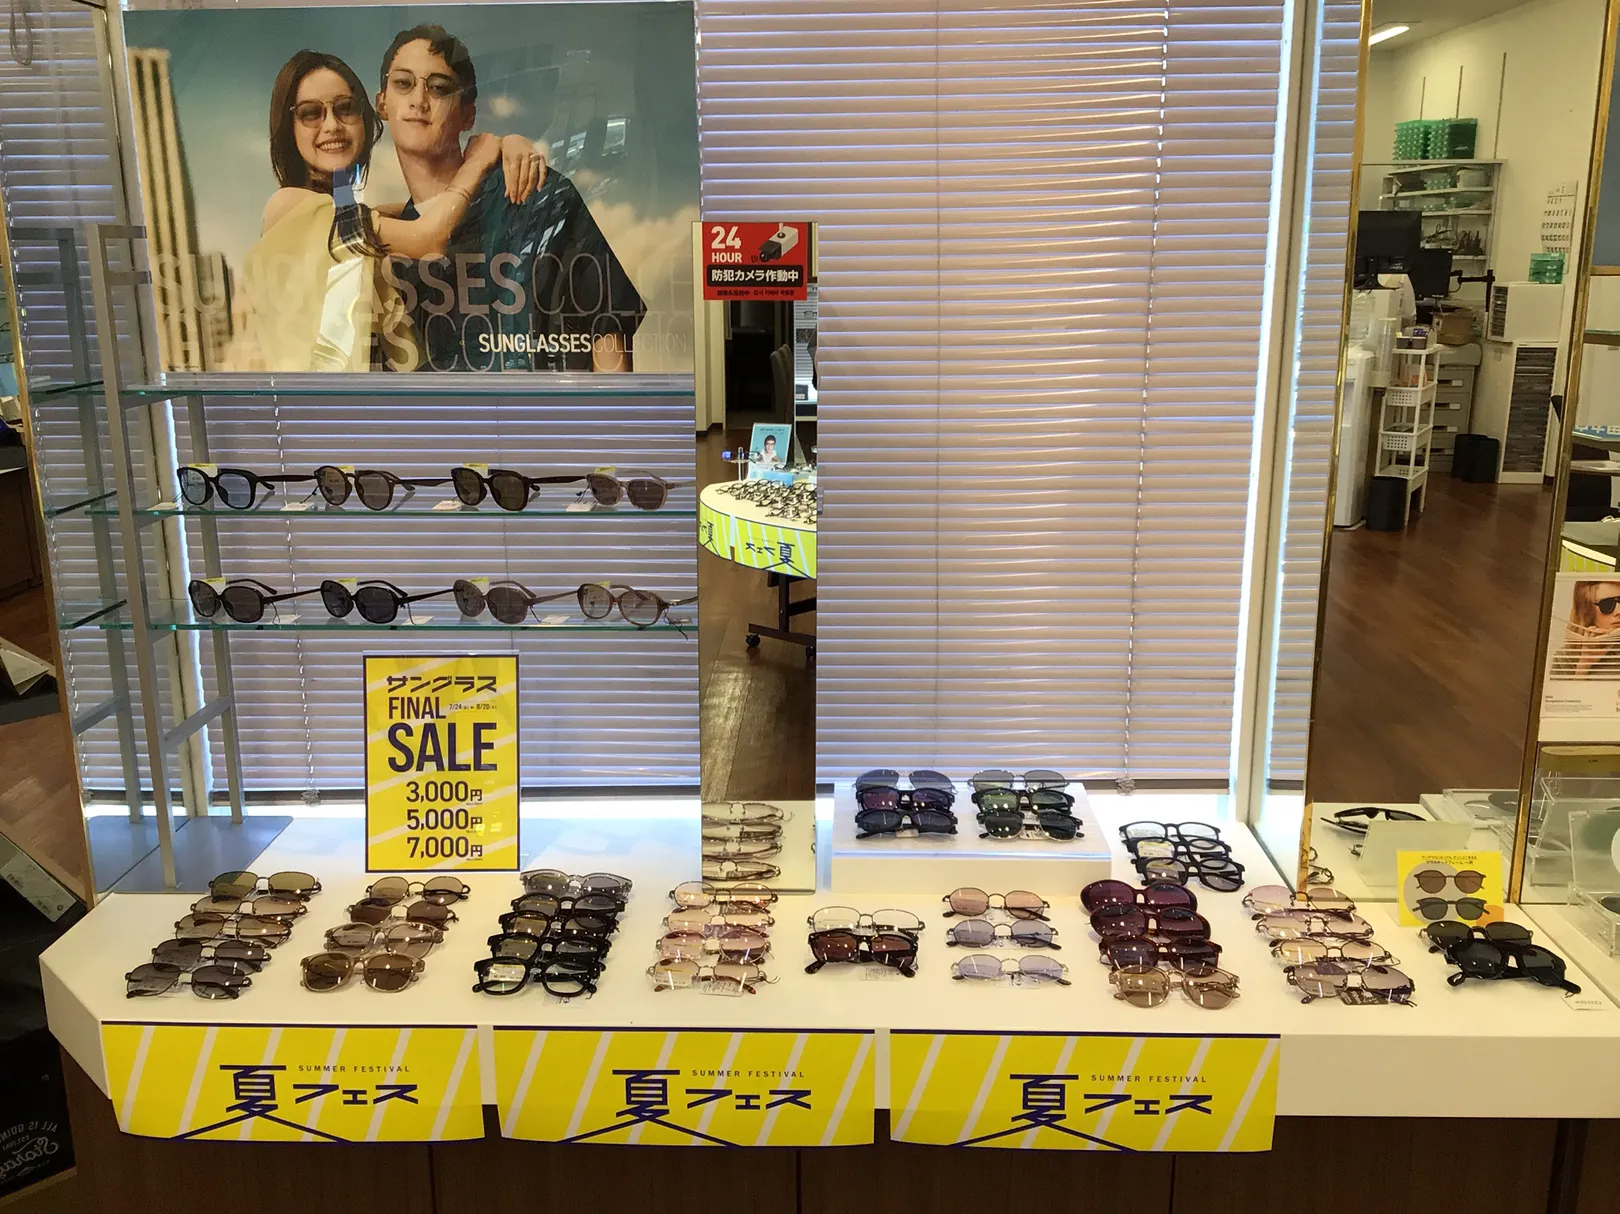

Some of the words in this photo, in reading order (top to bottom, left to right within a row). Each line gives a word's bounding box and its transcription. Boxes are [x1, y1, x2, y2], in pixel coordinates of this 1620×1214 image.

[711, 226, 742, 249] 24
[711, 252, 742, 263] HOUR
[711, 269, 799, 282] 防犯カメラ作動中
[478, 333, 591, 353] SUNGLASSES
[386, 676, 497, 693] サングラス
[388, 697, 447, 719] FINAL
[387, 722, 498, 772] SALE
[406, 781, 483, 803] 3,000円
[407, 837, 483, 859] 7,000円
[298, 1065, 346, 1073] SUMMER
[692, 1070, 741, 1078] SUMMER
[1091, 1074, 1141, 1082] SUMMER
[205, 1065, 419, 1135] 夏フェス
[597, 1069, 812, 1139] 夏フェス
[990, 1074, 1213, 1145] 夏フェス
